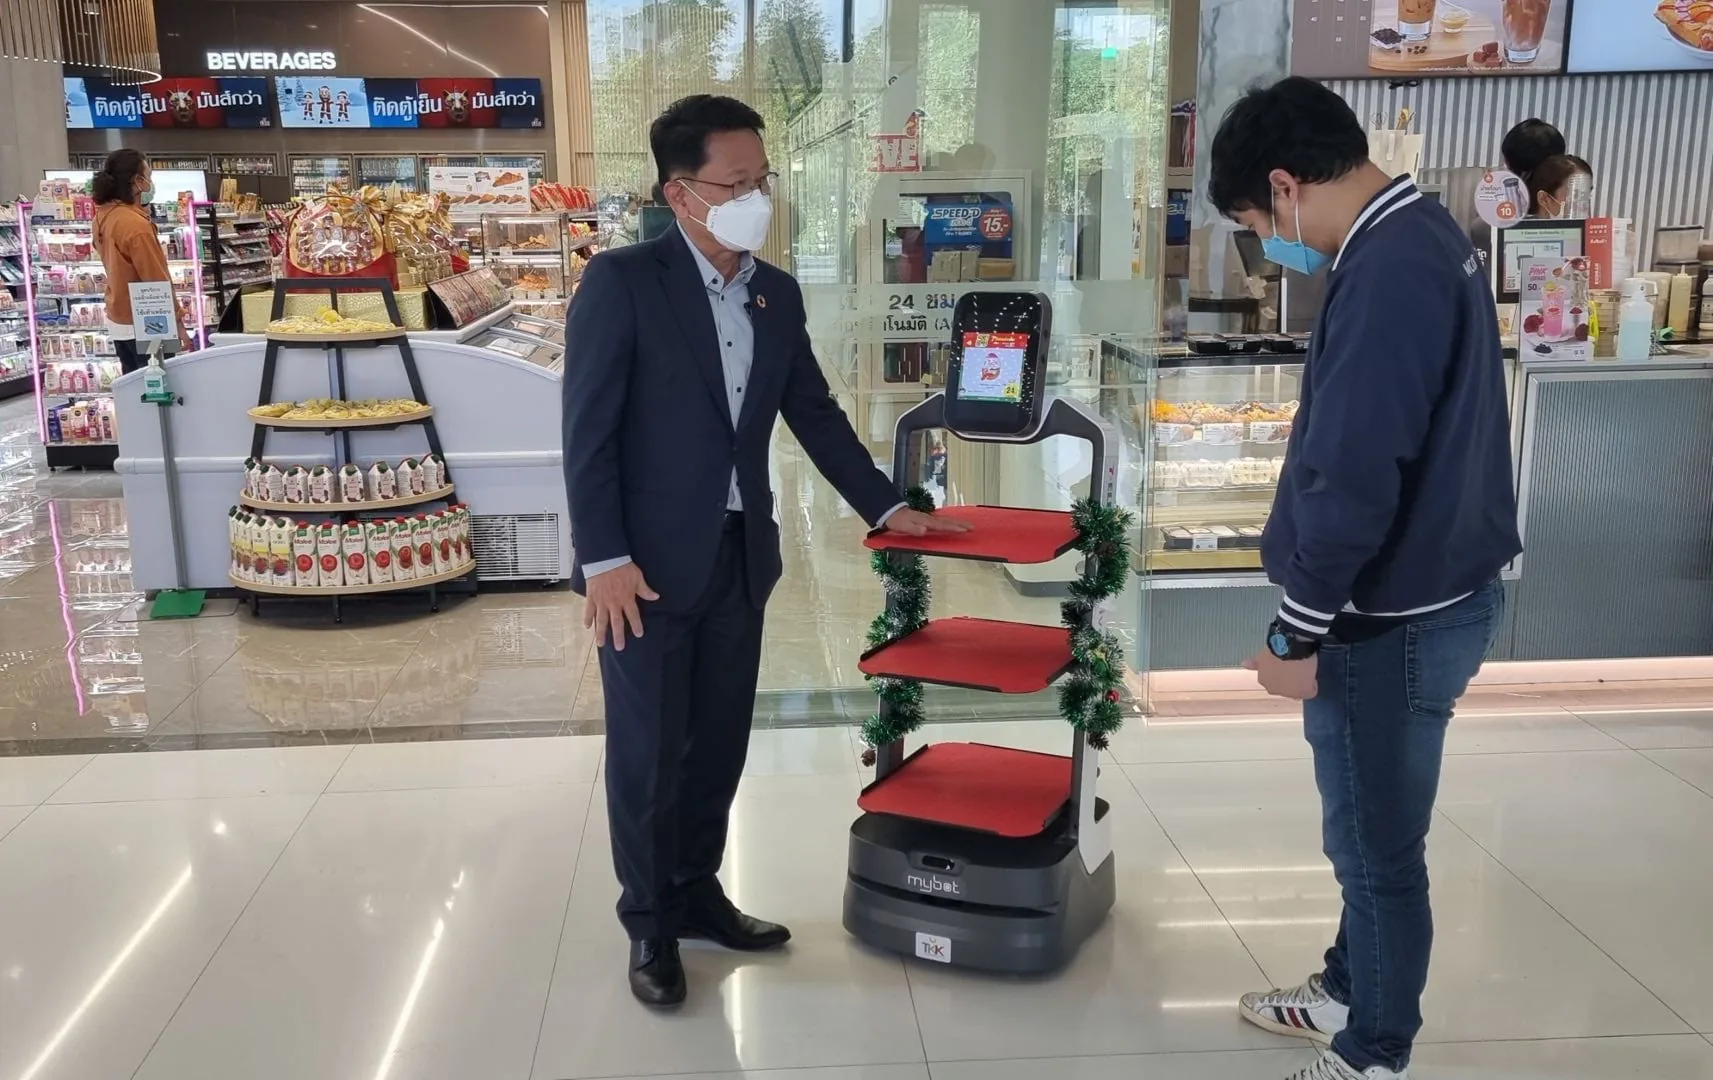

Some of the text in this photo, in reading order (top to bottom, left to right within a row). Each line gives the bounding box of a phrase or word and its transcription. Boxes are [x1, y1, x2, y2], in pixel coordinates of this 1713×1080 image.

[206, 52, 337, 70] BEVERAGES
[94, 90, 262, 121] ติดตู้เย็น มันส์กว่า
[373, 90, 536, 121] ติดตู้เย็น มันส์กว่า
[1501, 208, 1512, 216] 10
[888, 294, 915, 310] 24
[934, 317, 952, 331] (A
